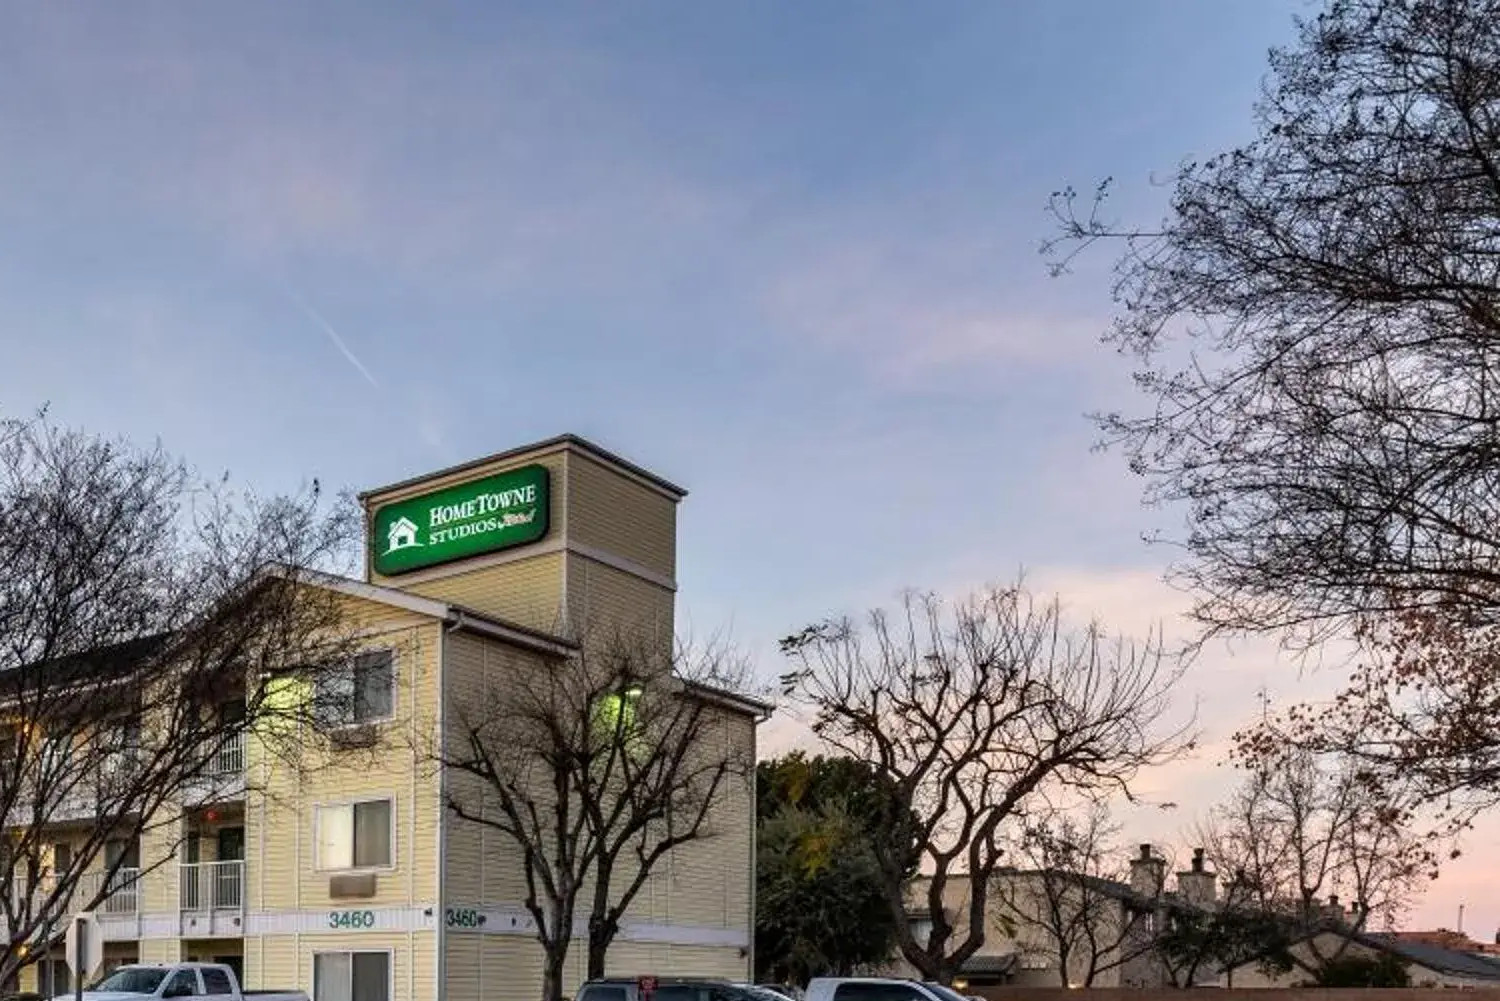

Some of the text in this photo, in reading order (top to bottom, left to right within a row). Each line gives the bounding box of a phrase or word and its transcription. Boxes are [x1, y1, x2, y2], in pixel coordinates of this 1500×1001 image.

[429, 518, 496, 545] STUDIOS
[329, 910, 375, 929] 3460
[446, 909, 477, 927] 3460
